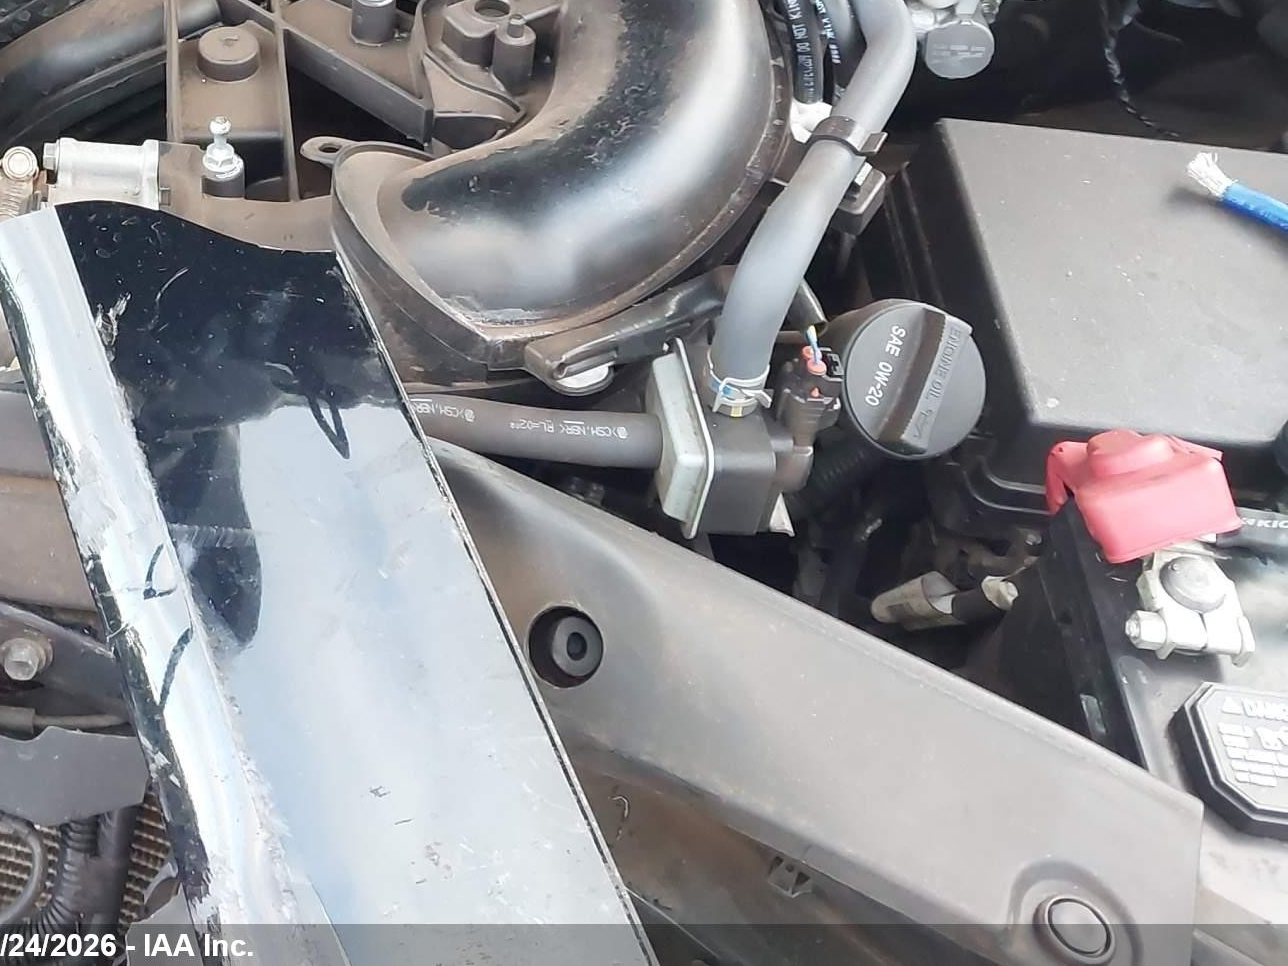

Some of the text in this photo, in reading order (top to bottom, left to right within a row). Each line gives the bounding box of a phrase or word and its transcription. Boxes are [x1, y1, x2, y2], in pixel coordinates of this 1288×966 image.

[864, 325, 907, 407] SAE 0W-20
[925, 328, 962, 401] ENGINE OIL
